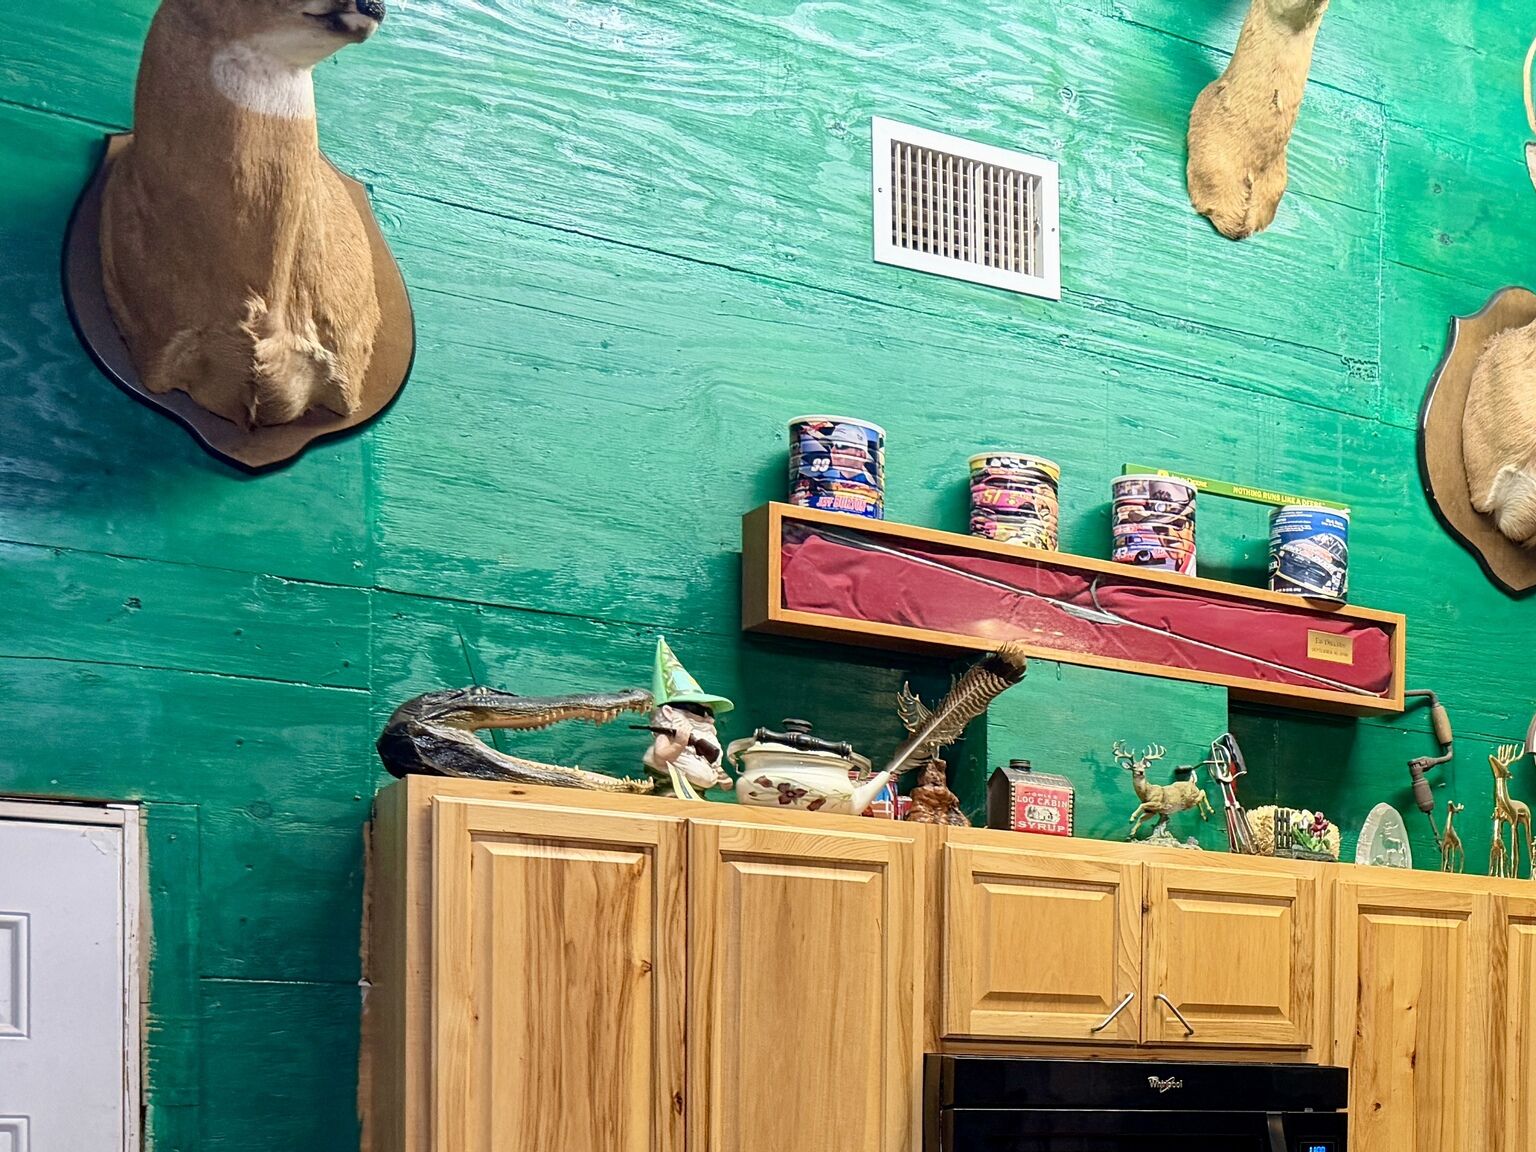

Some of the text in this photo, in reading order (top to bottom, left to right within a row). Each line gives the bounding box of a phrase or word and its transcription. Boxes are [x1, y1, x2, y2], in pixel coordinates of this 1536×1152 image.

[811, 458, 831, 472] 99
[1232, 486, 1262, 498] NOTHING
[1263, 492, 1281, 502] RUNS
[1281, 495, 1296, 504] LIKE
[1037, 797, 1068, 808] CABIN
[1017, 820, 1066, 832] SYRUP
